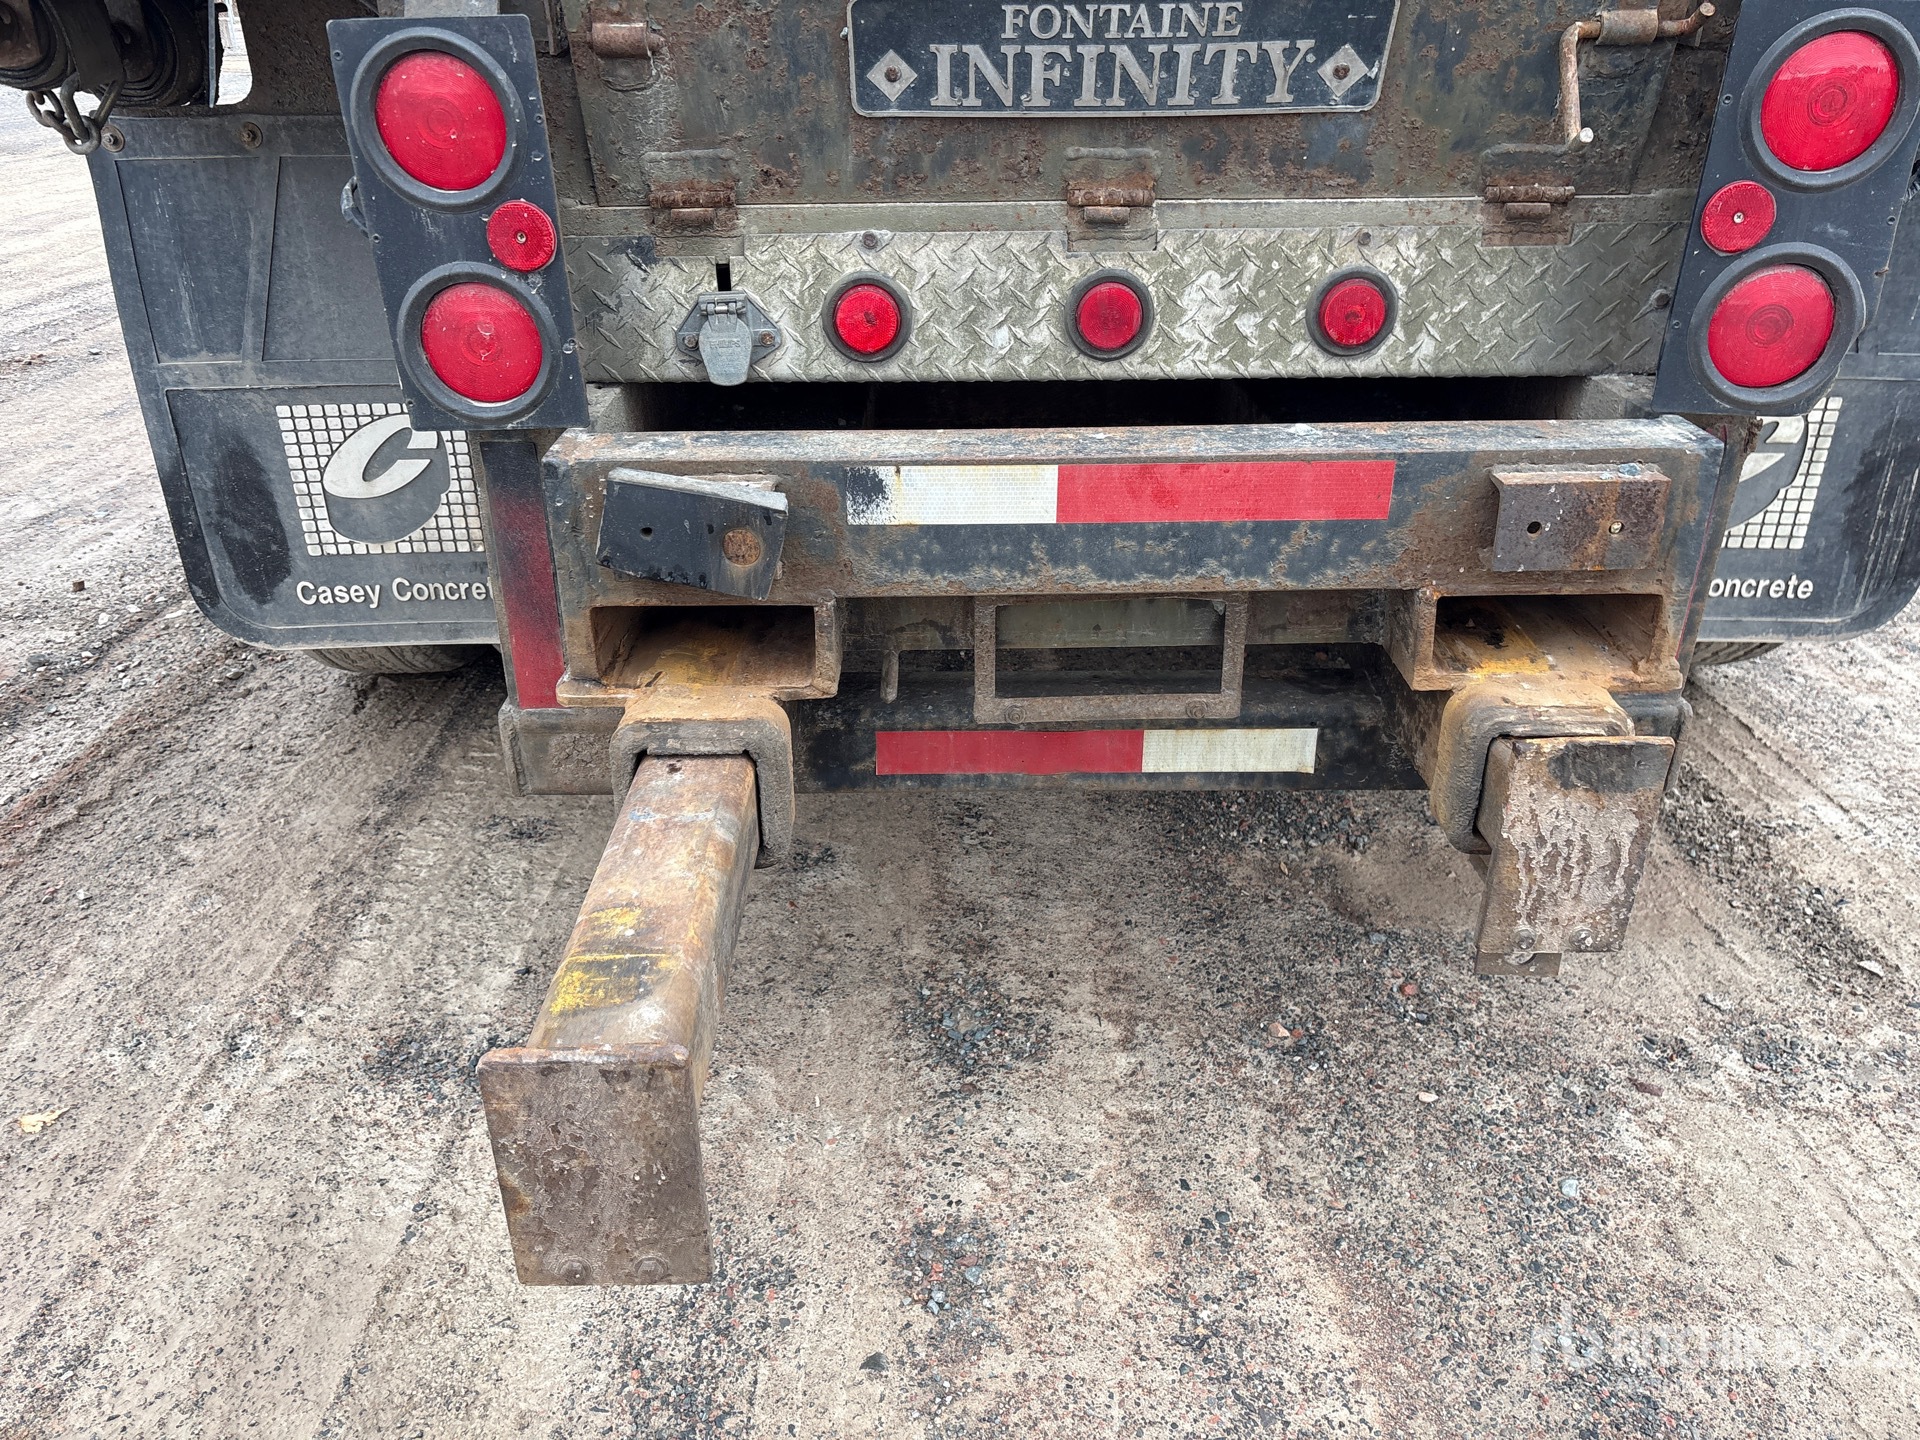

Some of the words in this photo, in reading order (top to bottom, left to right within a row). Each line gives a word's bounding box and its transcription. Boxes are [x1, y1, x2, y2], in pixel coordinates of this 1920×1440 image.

[1001, 3, 1244, 40] FONTAINE
[928, 39, 1317, 108] INFINITY
[296, 580, 381, 609] Casey
[391, 576, 495, 601] Concre
[1708, 573, 1814, 600] oncrete
